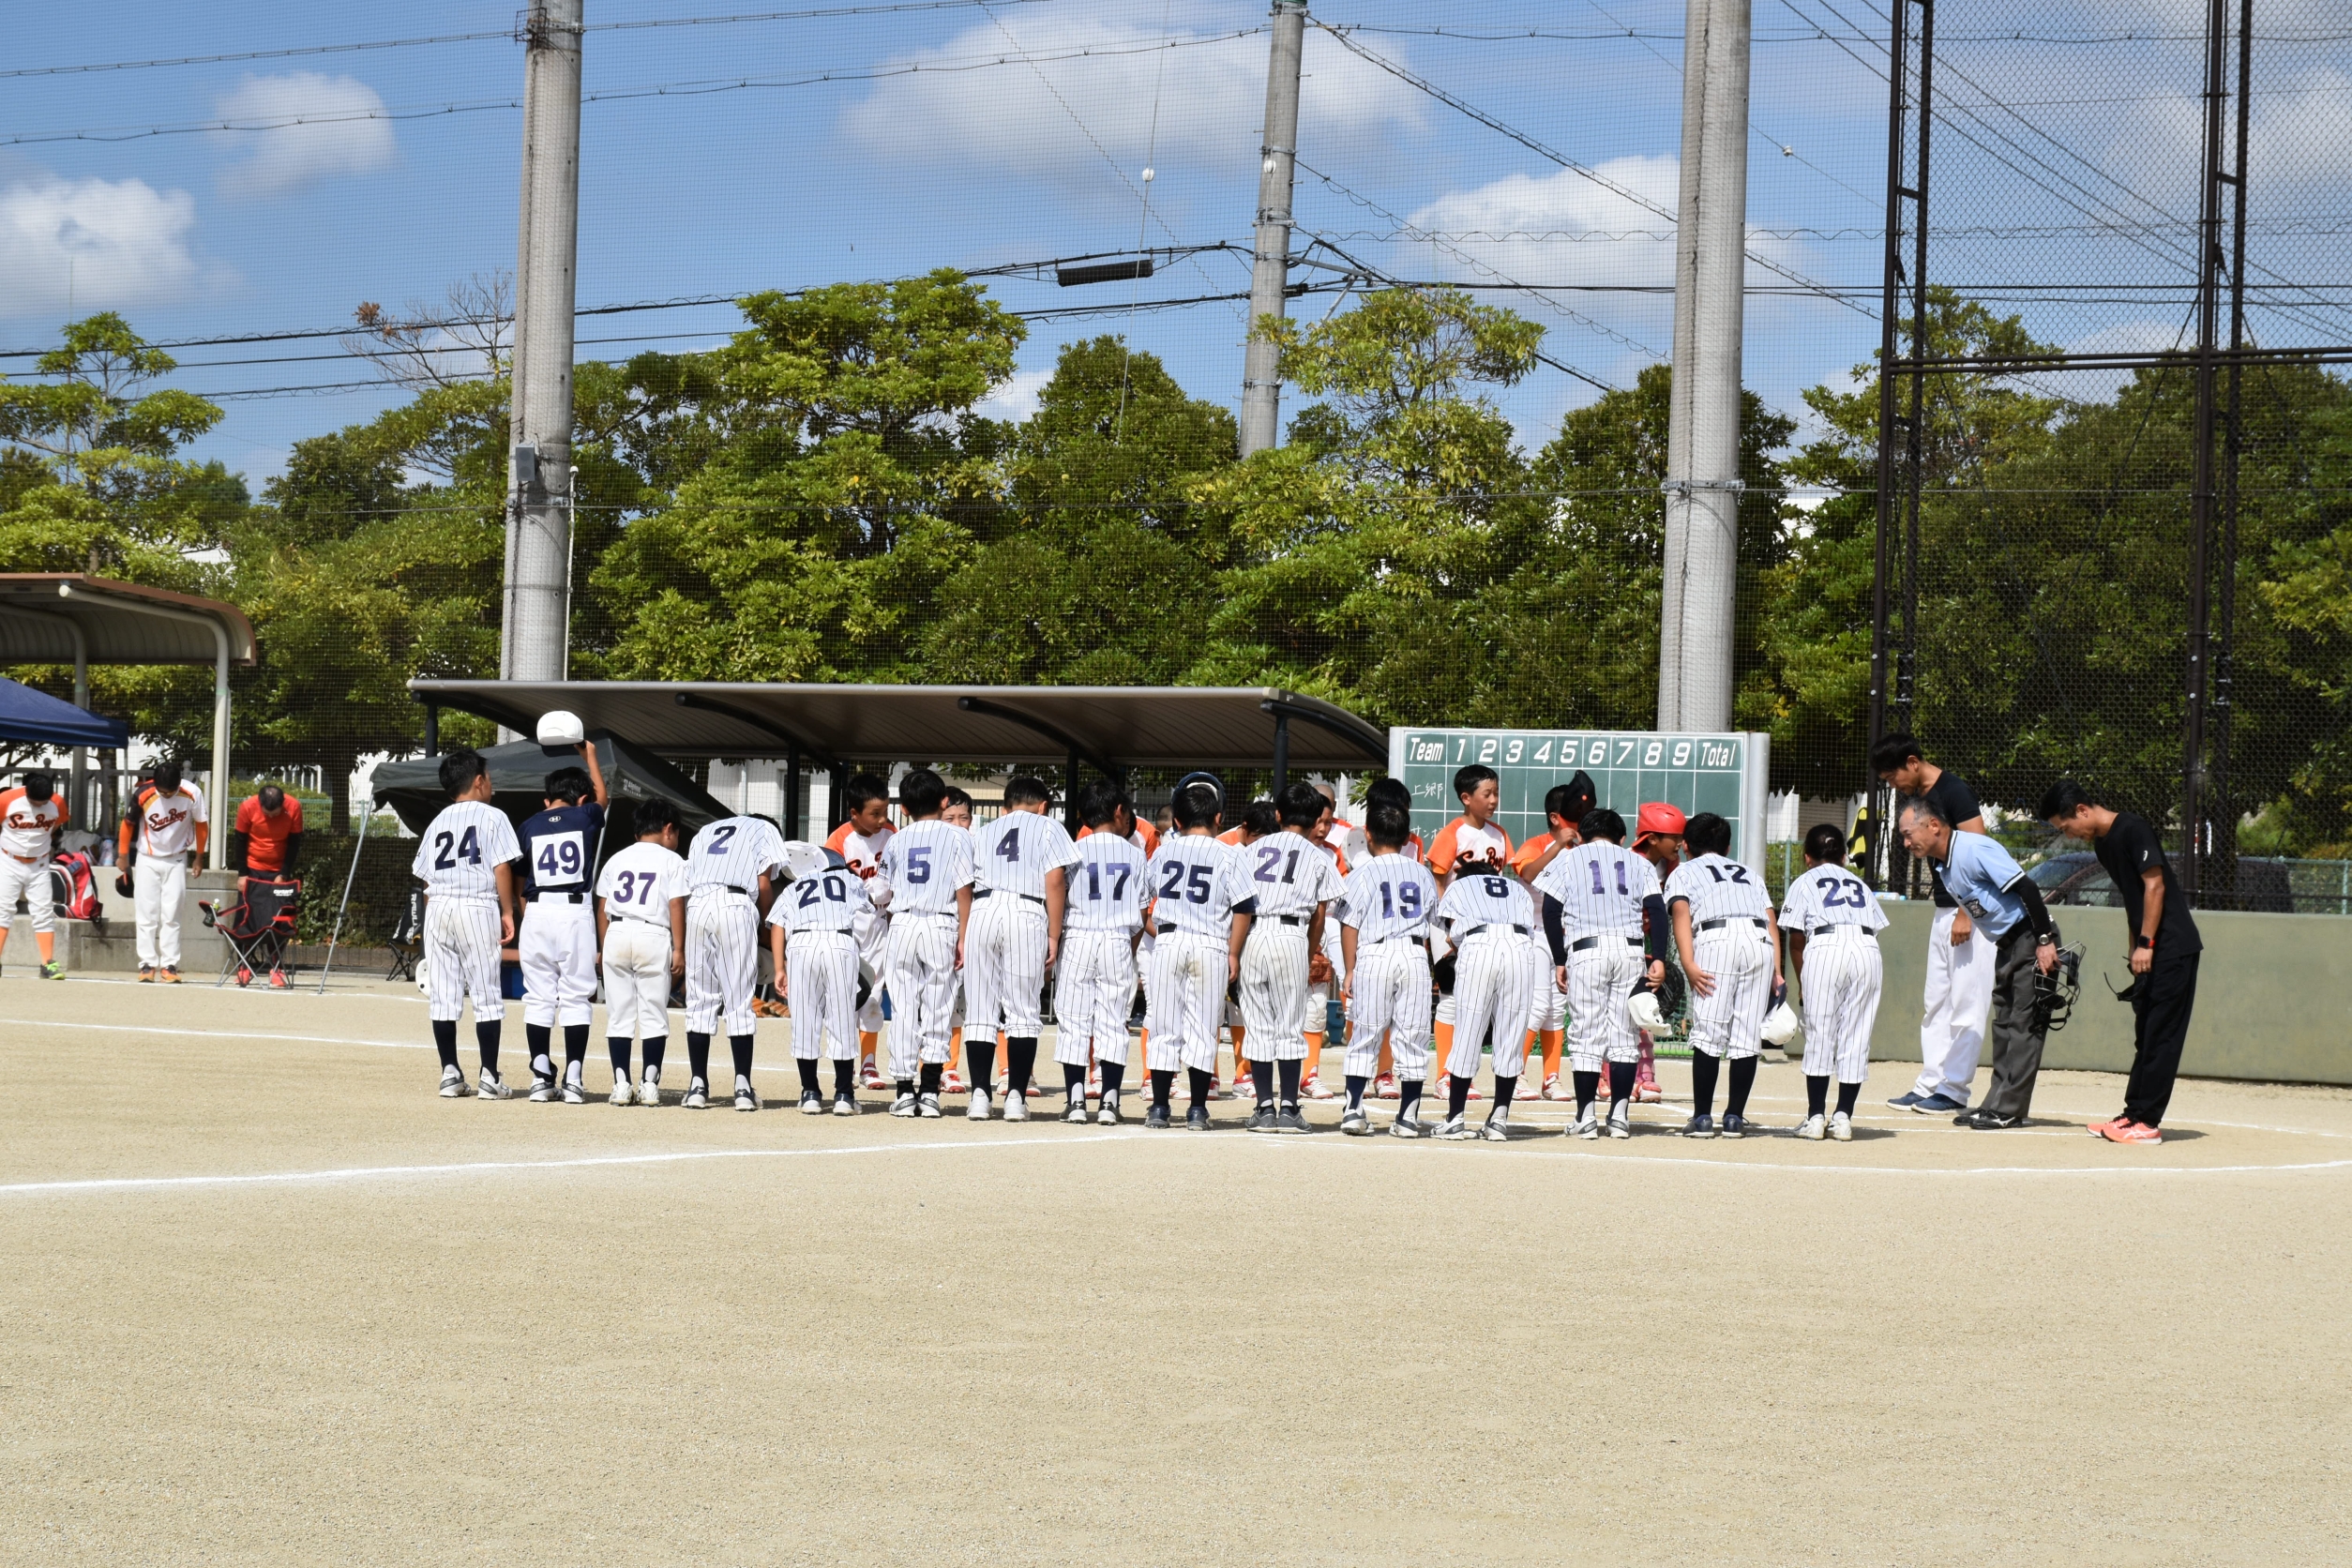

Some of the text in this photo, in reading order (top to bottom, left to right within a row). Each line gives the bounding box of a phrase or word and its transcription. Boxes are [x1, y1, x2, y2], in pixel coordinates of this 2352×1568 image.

[1409, 737, 1736, 767] Team 1 2 3 4 5 6 7 8 9 Total
[1411, 781, 1444, 800] 上郷
[8, 813, 35, 830] Sun
[148, 807, 188, 831] Sun Boys
[434, 825, 482, 870] 24
[707, 825, 737, 854] 2
[996, 827, 1020, 862] 4
[537, 840, 580, 876] 49
[907, 847, 931, 884] 5
[1254, 847, 1301, 884] 21
[1706, 865, 1751, 884] 12
[613, 870, 657, 905] 37
[795, 876, 846, 910] 20
[1087, 863, 1131, 901] 17
[1158, 860, 1214, 904] 25
[1484, 877, 1509, 898] 8
[1589, 860, 1629, 896] 11
[1817, 877, 1866, 909] 23
[1380, 882, 1421, 919] 19
